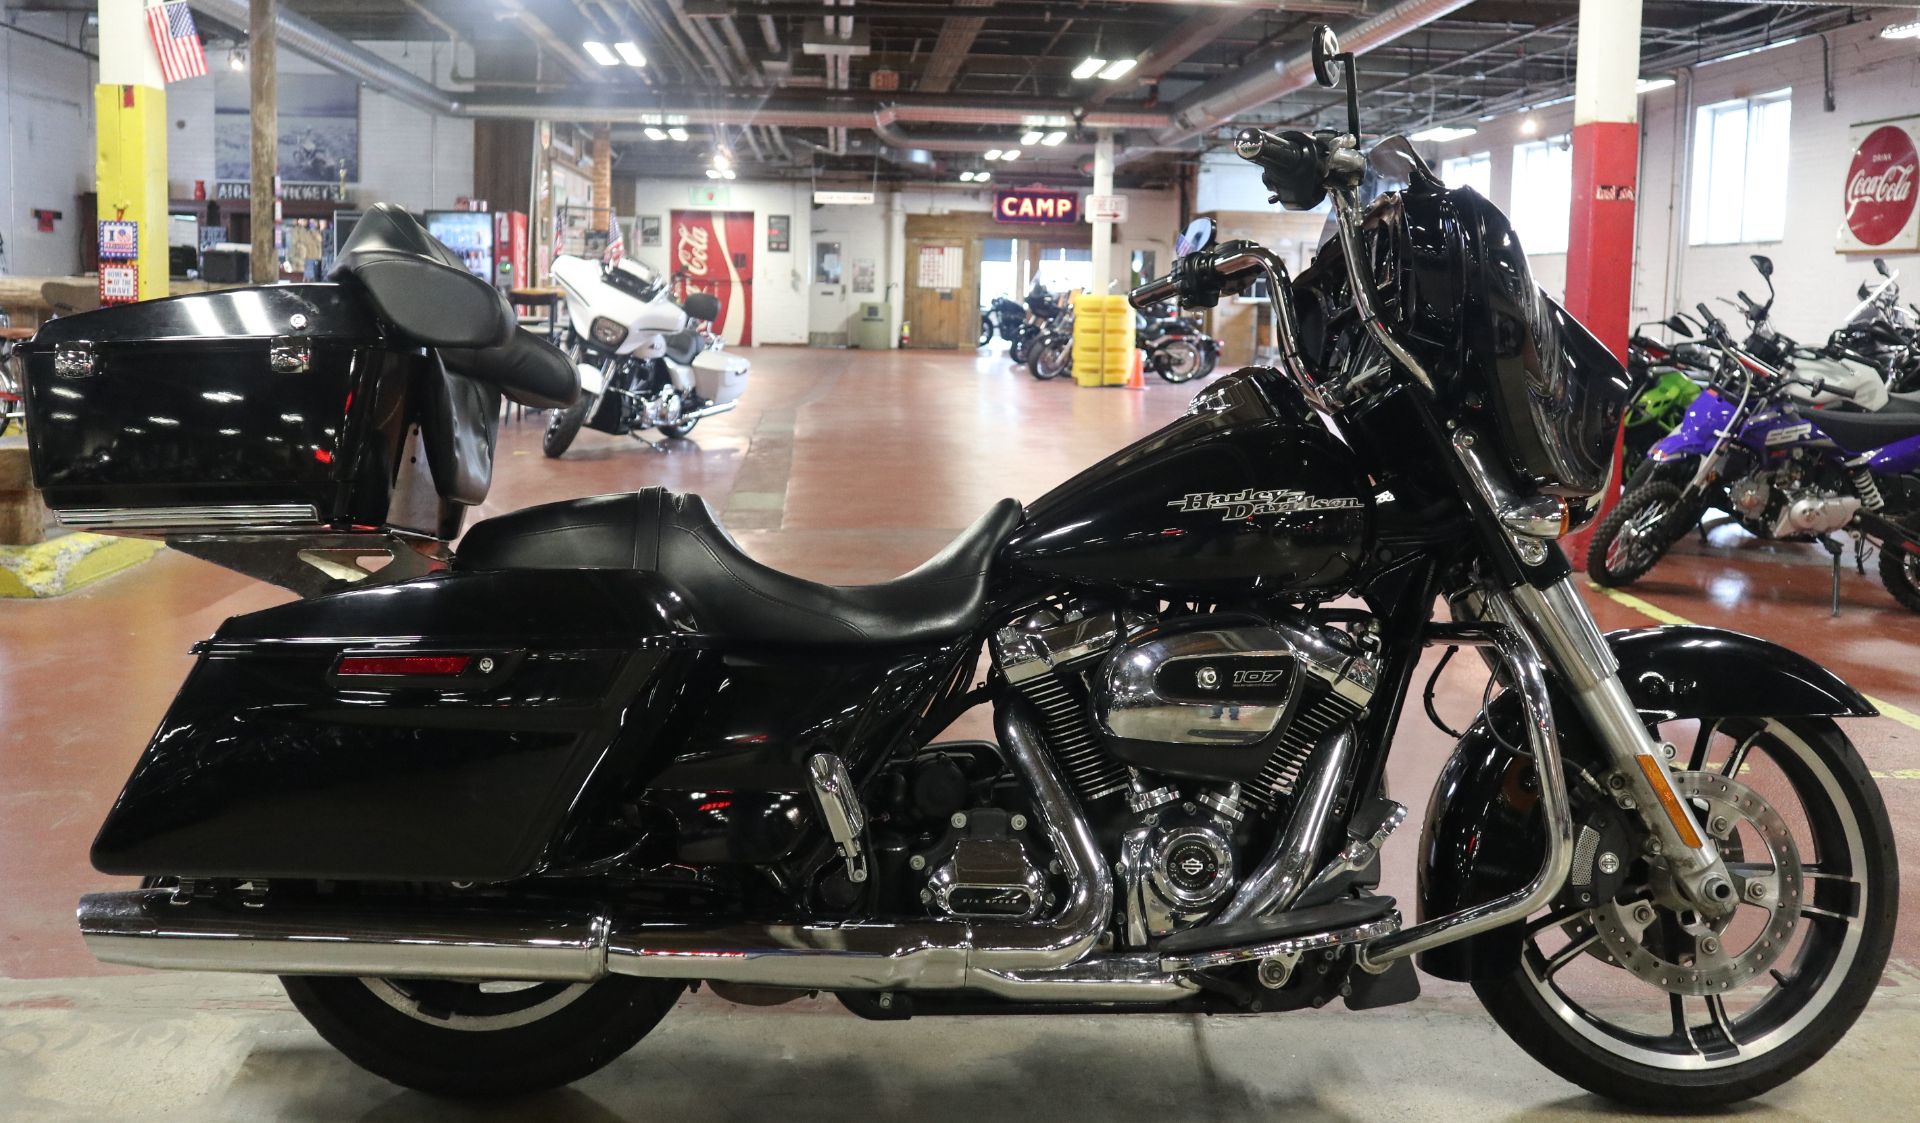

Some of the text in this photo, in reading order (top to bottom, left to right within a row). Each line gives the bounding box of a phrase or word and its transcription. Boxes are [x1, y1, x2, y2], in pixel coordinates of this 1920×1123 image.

[1872, 153, 1892, 163] DRINK
[1001, 197, 1072, 218] CAMP
[1167, 489, 1306, 512] Harley
[1222, 496, 1365, 521] Davidson
[1233, 670, 1283, 684] 107
